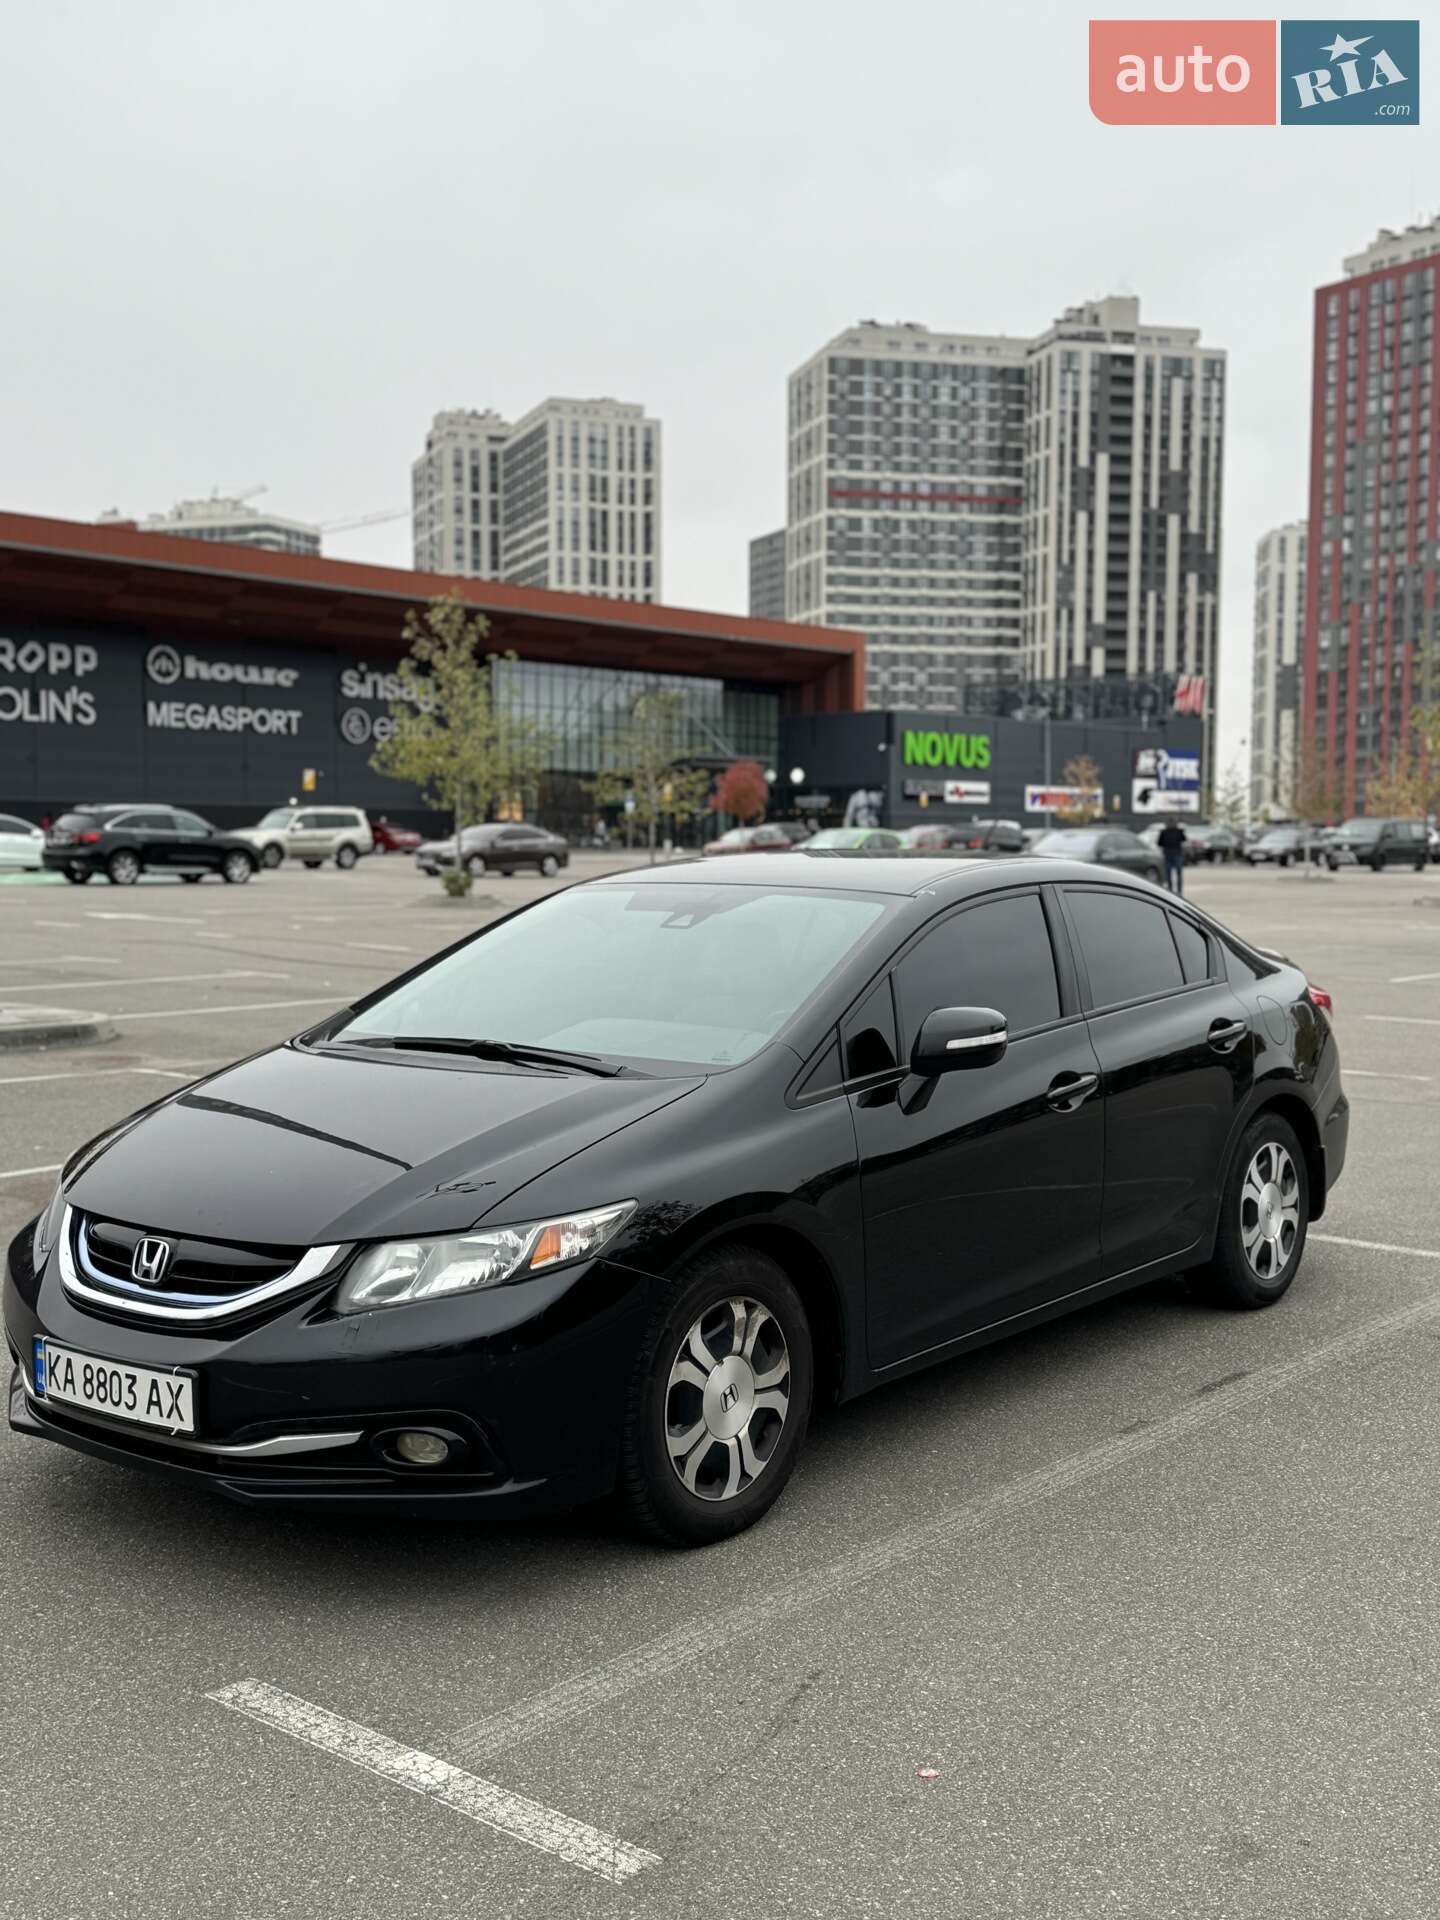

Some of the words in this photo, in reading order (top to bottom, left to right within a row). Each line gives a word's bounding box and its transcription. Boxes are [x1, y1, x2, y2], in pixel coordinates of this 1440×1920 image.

[147, 701, 303, 735] MEGASPORT
[904, 729, 991, 769] NOVUS
[48, 1351, 76, 1395] KA
[83, 1363, 137, 1411] 8803
[146, 1378, 185, 1422] AX
